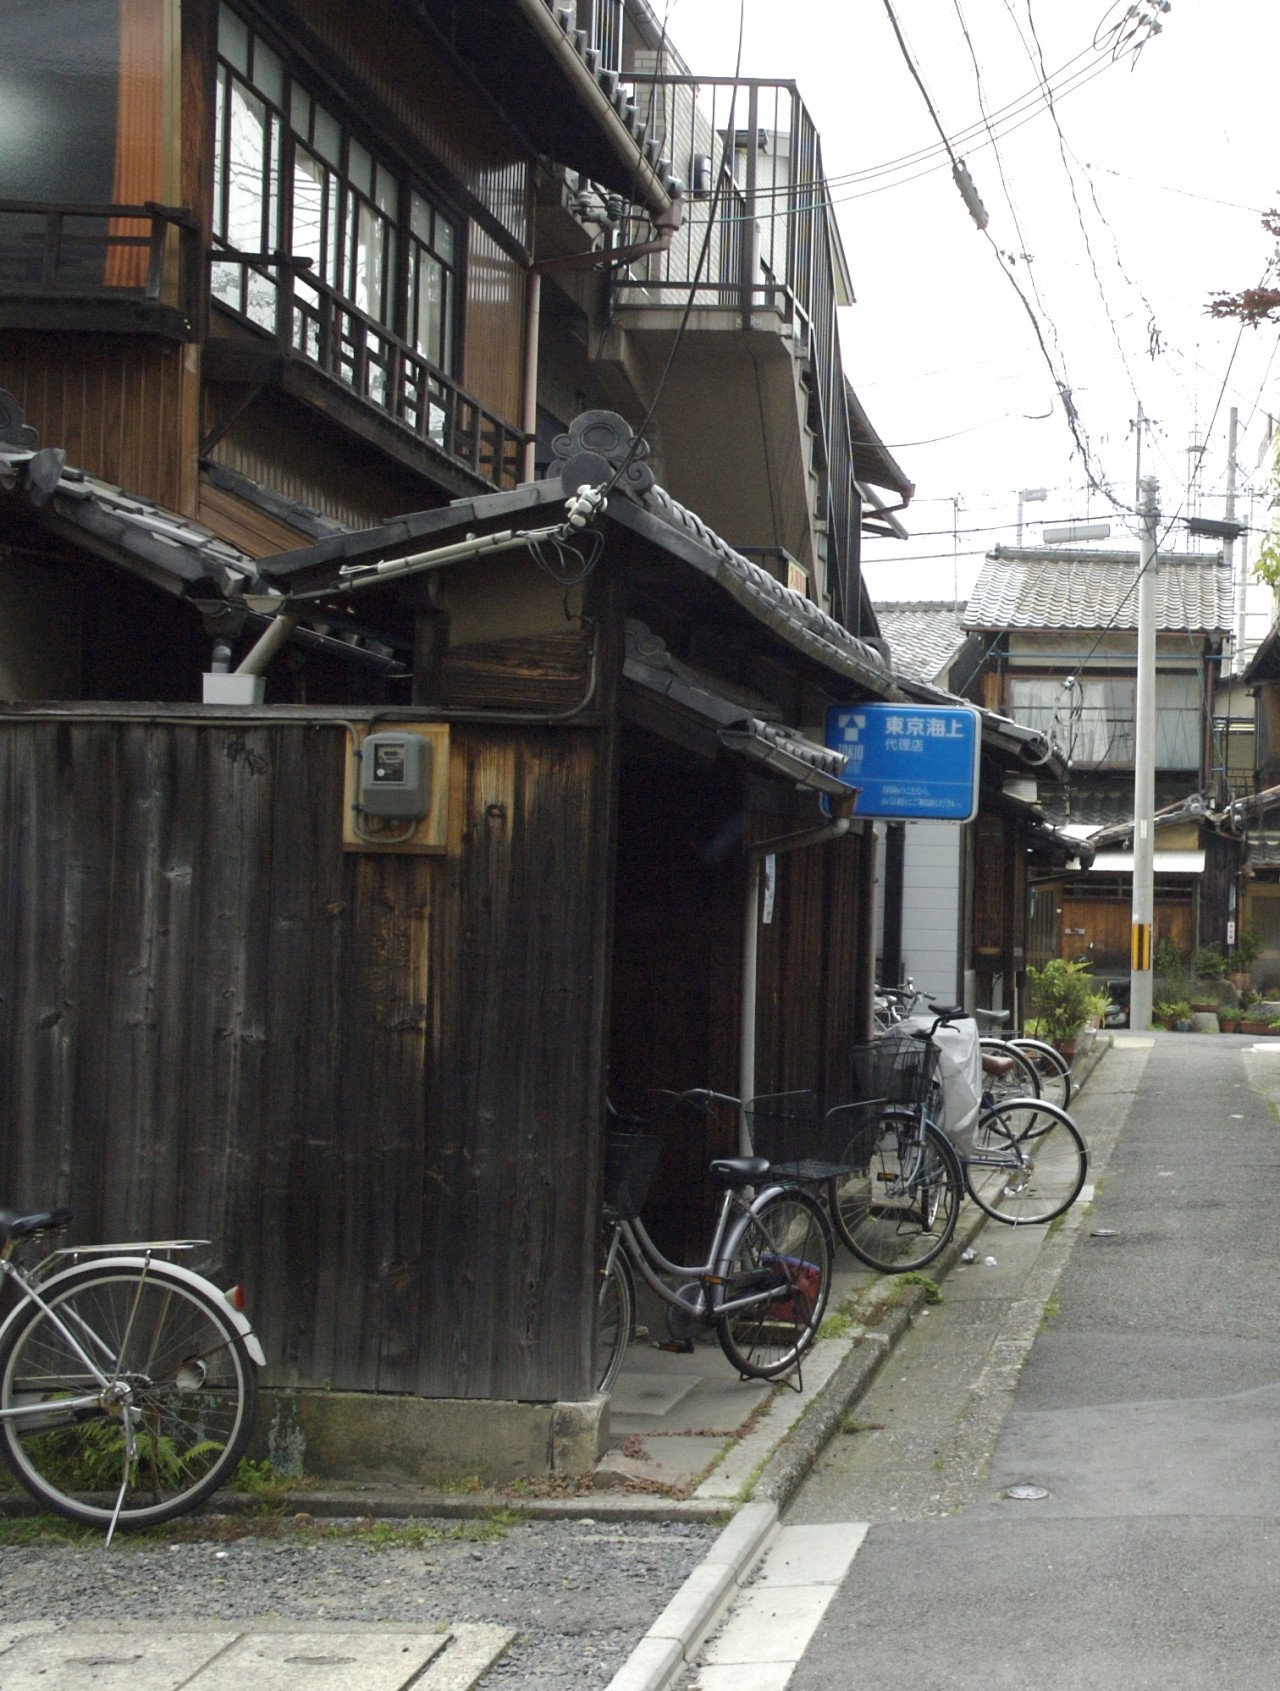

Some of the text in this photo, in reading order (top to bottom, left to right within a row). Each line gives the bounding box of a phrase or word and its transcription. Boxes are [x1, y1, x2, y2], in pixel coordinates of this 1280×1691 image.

[885, 716, 964, 738] 東京海上
[885, 738, 924, 753] 代理店
